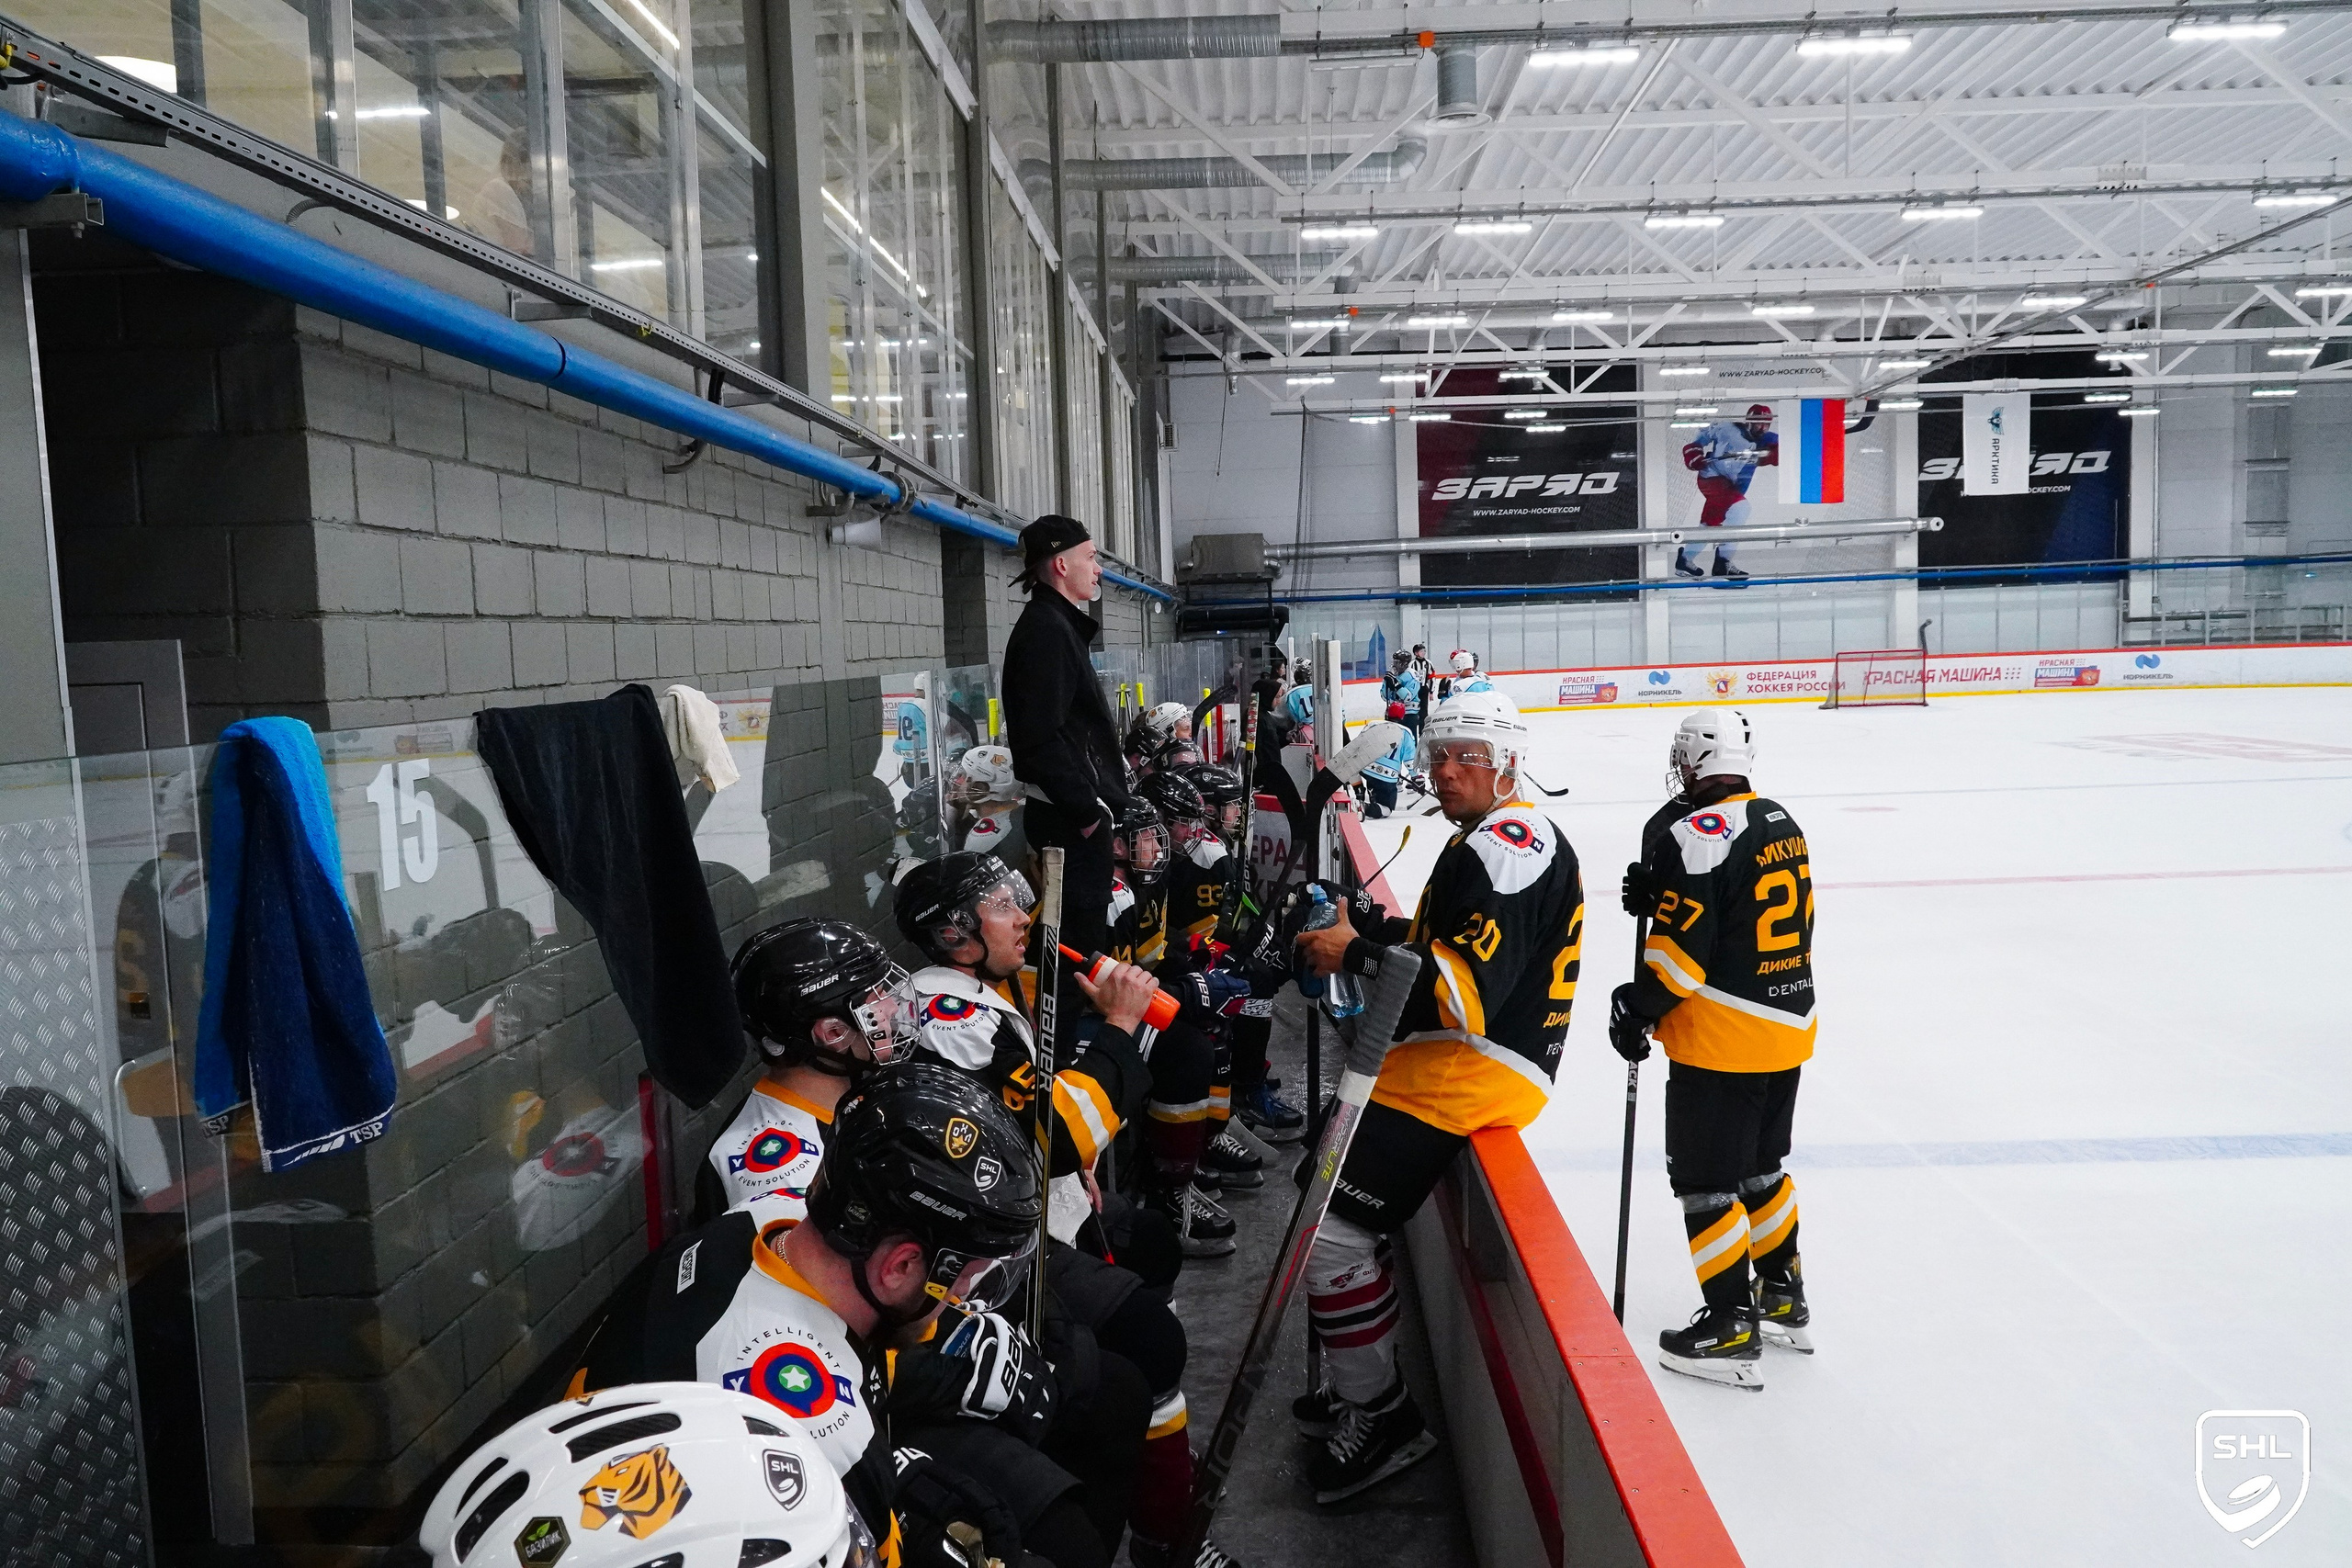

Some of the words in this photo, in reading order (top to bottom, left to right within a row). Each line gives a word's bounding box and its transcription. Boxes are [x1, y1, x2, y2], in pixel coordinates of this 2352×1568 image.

[1991, 438, 2000, 485] АРКТИКА
[1473, 505, 1580, 516] WWW.ZARYAD-HOCKEY.COM
[2037, 667, 2075, 678] МАШИНА
[2039, 659, 2075, 667] КРАСНАЯ
[1563, 675, 1595, 684] КРАСНАЯ
[1747, 670, 1817, 682] ФЕДЕРАЦИЯ
[1939, 667, 2001, 682] МАШИНА
[1561, 684, 1596, 695] МАШИНА
[1747, 682, 1793, 694] ХОККЕЯ
[367, 758, 438, 891] 15
[1484, 833, 1502, 848] EVENT
[915, 903, 940, 922] BAUER
[1656, 889, 1705, 932] 27
[1453, 912, 1502, 963] 20
[1757, 954, 1802, 976] ДИКИЕ
[800, 974, 840, 998] BAUER
[932, 1023, 956, 1032] EVENT
[1038, 992, 1057, 1093] BAUER
[350, 1122, 384, 1145] TSP
[952, 1122, 972, 1143] ОХЛ
[738, 1175, 763, 1187] EVENT
[765, 1158, 810, 1186] SOLUTION
[979, 1162, 997, 1175] SHL
[1335, 1178, 1385, 1210] AUER
[910, 1190, 967, 1222] BAUER
[737, 1326, 841, 1370] INTELLIGENT
[729, 1376, 745, 1393] Y
[839, 1382, 853, 1402] N
[770, 1460, 798, 1474] SHL
